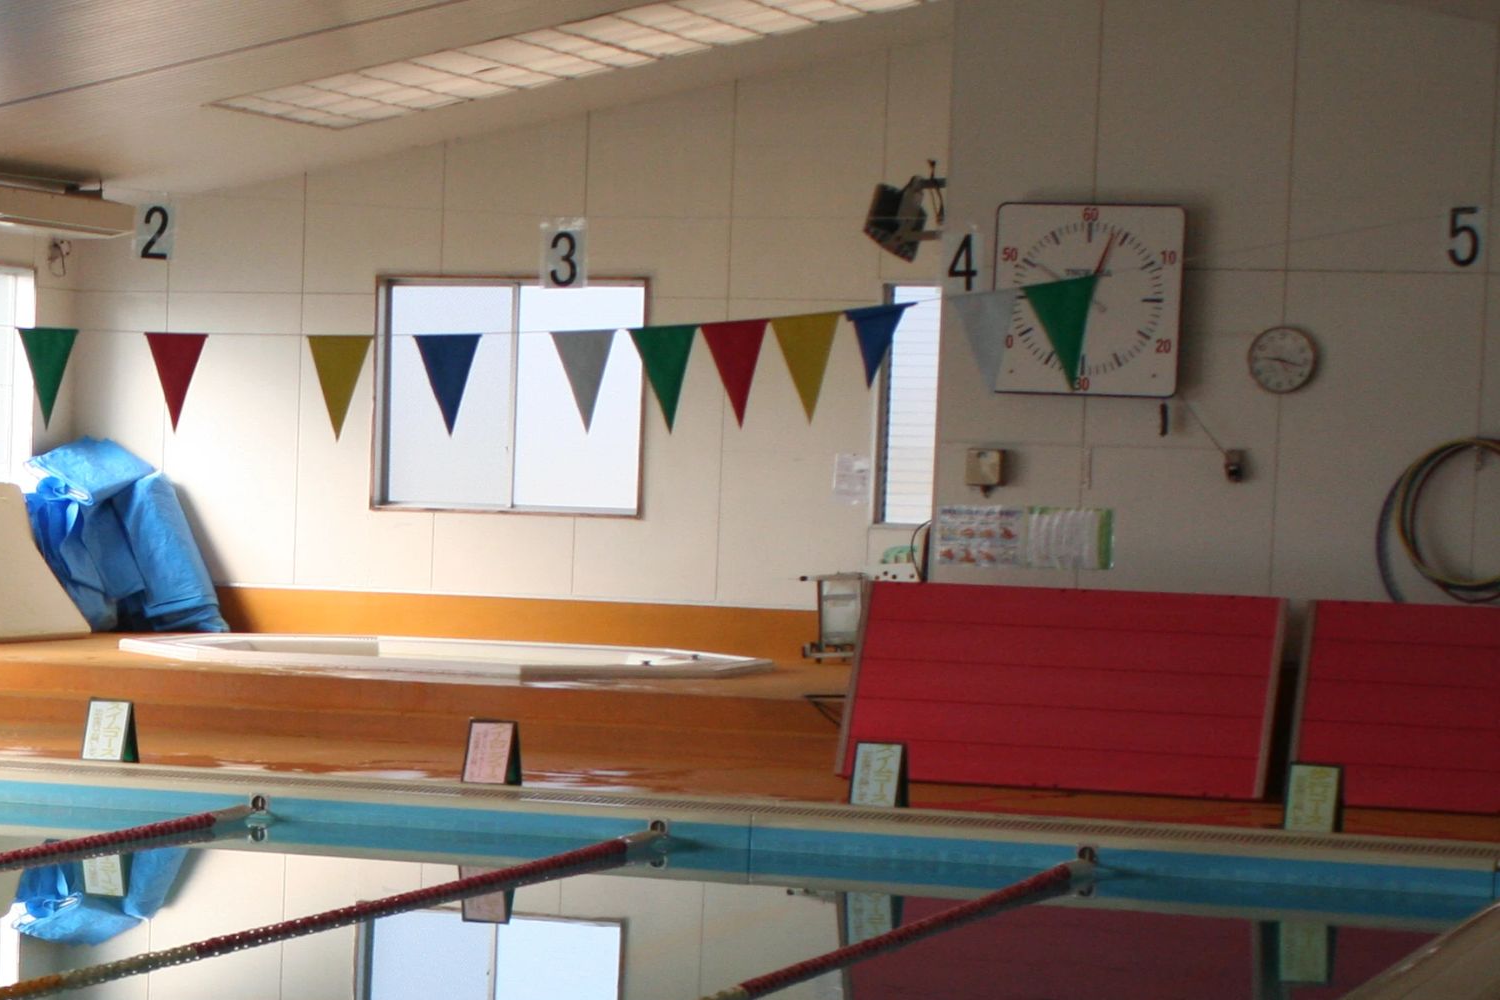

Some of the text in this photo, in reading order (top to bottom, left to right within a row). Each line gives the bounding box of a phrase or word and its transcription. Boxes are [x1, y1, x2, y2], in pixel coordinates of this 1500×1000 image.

[1082, 207, 1099, 222] 60
[141, 205, 169, 260] 2
[1448, 206, 1479, 267] 5
[550, 231, 577, 287] 3
[948, 233, 977, 291] 4
[1002, 247, 1018, 261] 50
[1160, 250, 1177, 264] 10
[1155, 338, 1171, 353] 20
